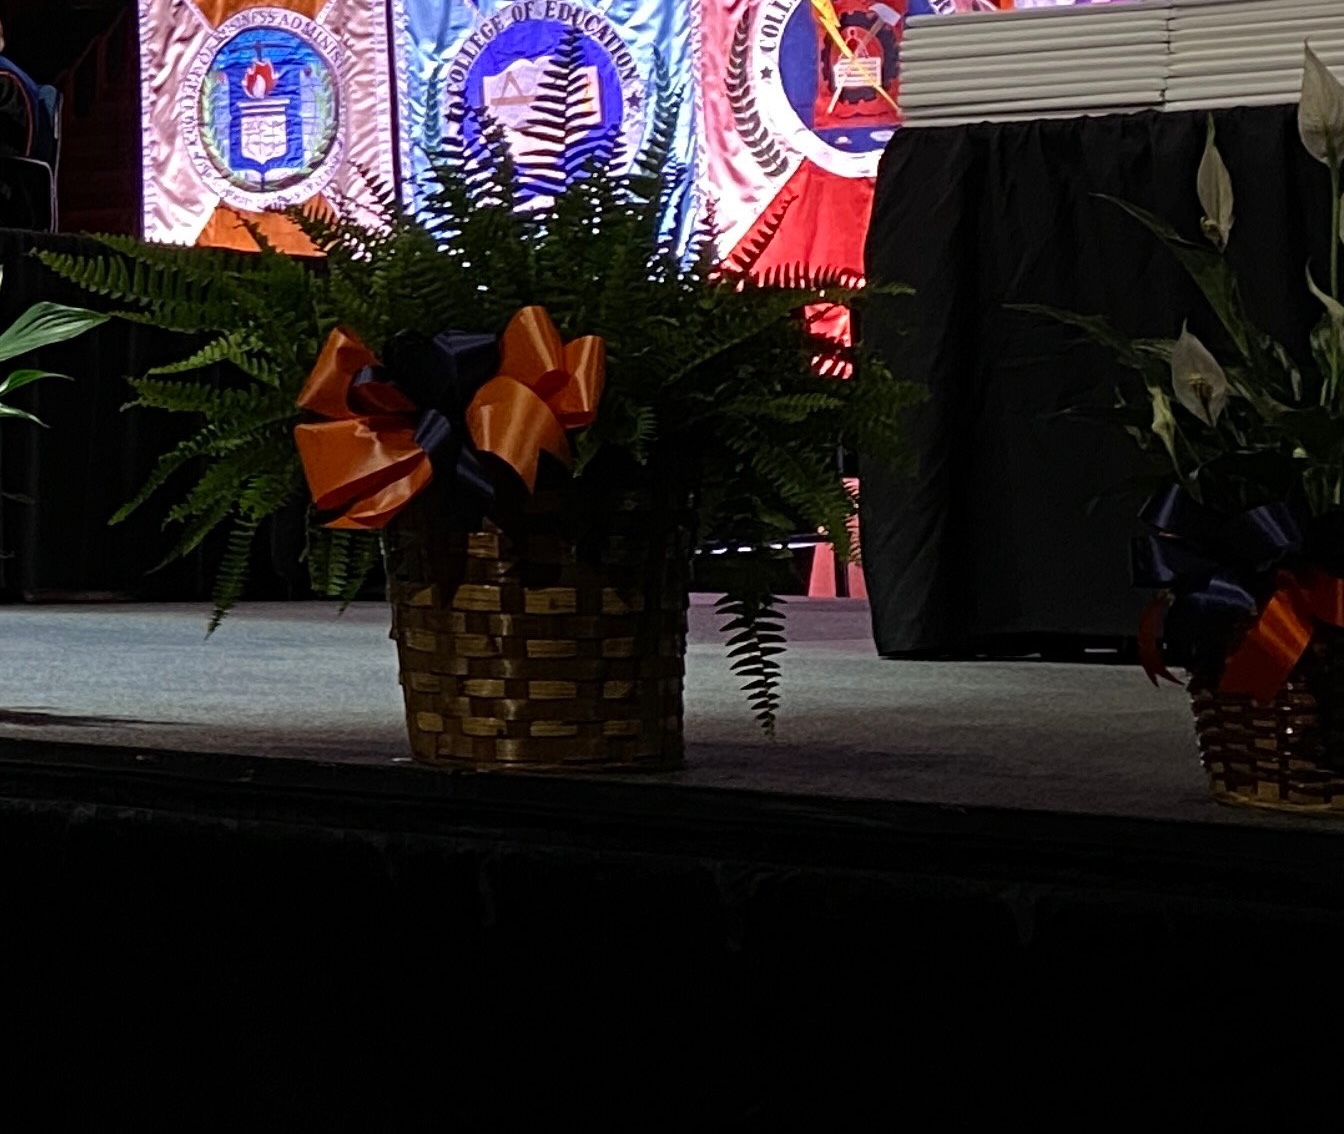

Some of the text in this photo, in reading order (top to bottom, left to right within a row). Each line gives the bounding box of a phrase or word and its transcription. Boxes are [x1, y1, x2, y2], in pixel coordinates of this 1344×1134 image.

[446, 0, 641, 98] COLLEGE OF EDUCATION
